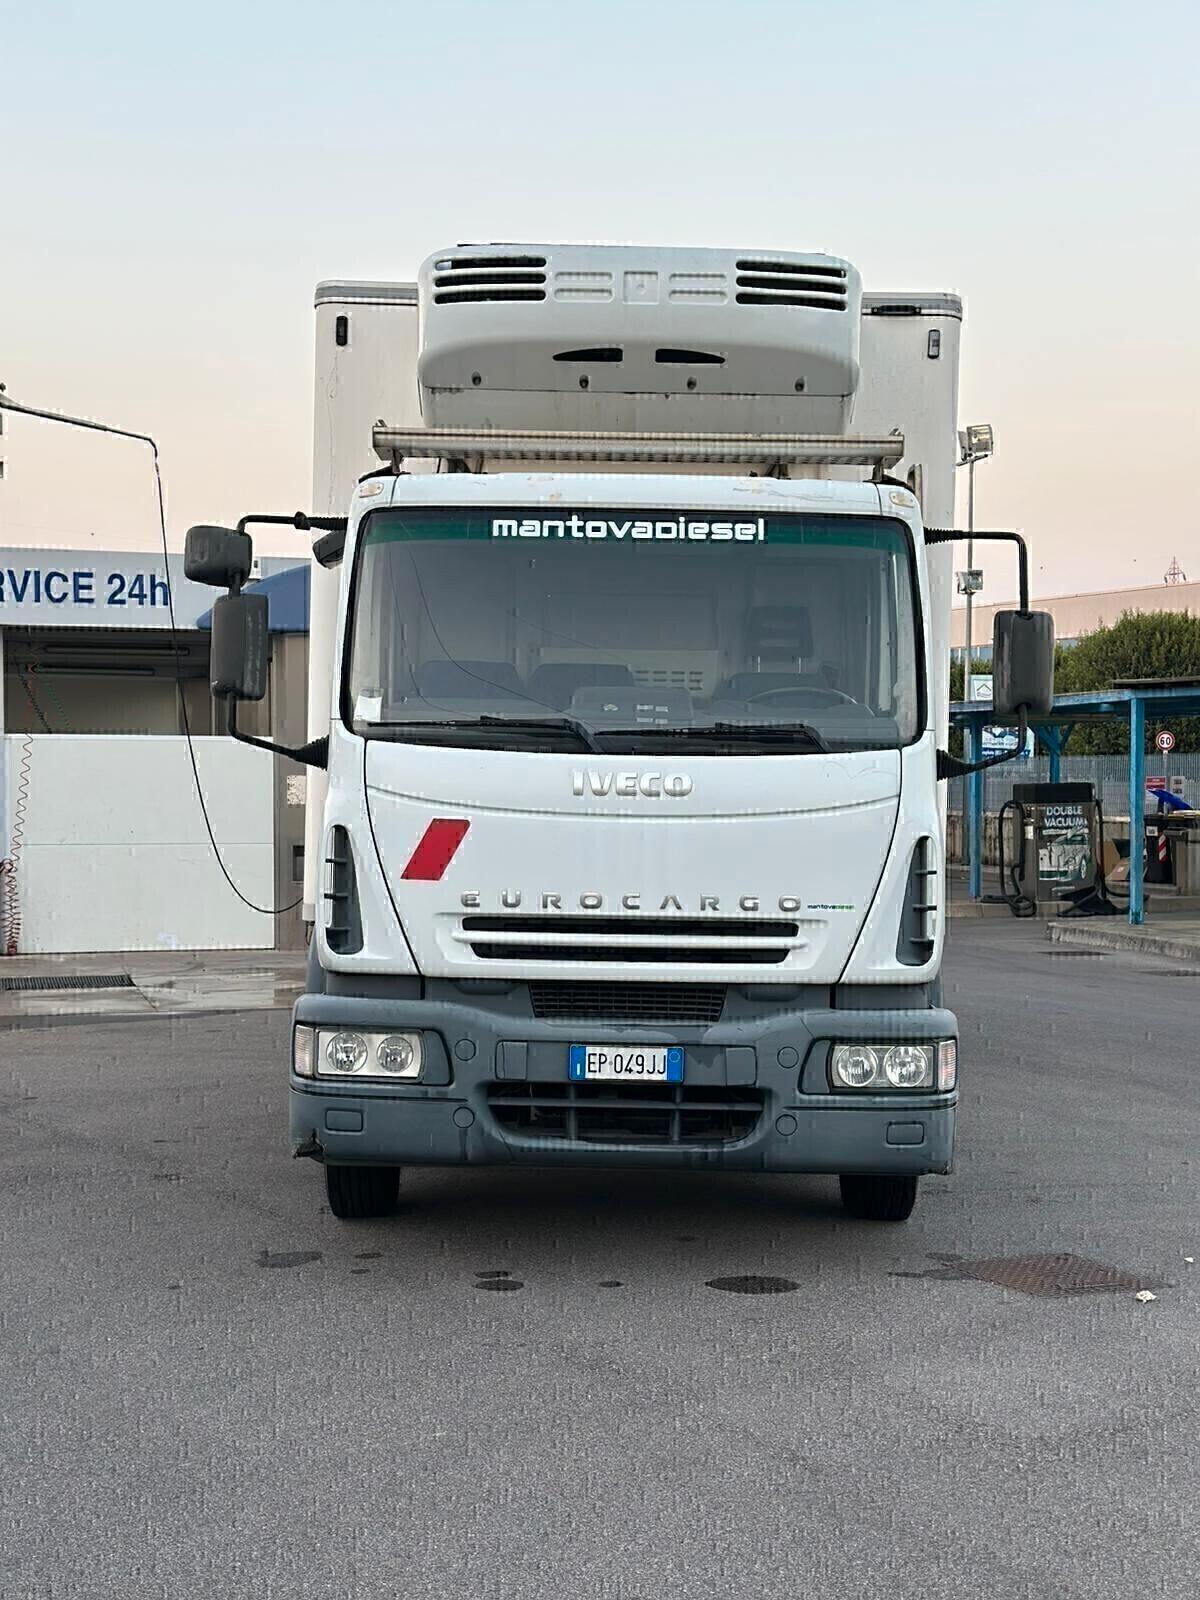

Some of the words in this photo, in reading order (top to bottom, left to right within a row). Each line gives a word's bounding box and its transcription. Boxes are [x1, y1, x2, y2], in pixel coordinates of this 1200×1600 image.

[0, 569, 95, 604] VICE
[107, 573, 169, 606] 24h
[1160, 737, 1171, 745] 60
[572, 769, 694, 797] IVECO
[1046, 805, 1083, 816] DOUBLE
[1044, 817, 1087, 827] VACUUM
[460, 890, 802, 913] EUROCARGO
[587, 1053, 608, 1073] EP
[613, 1053, 667, 1075] 049JJ
